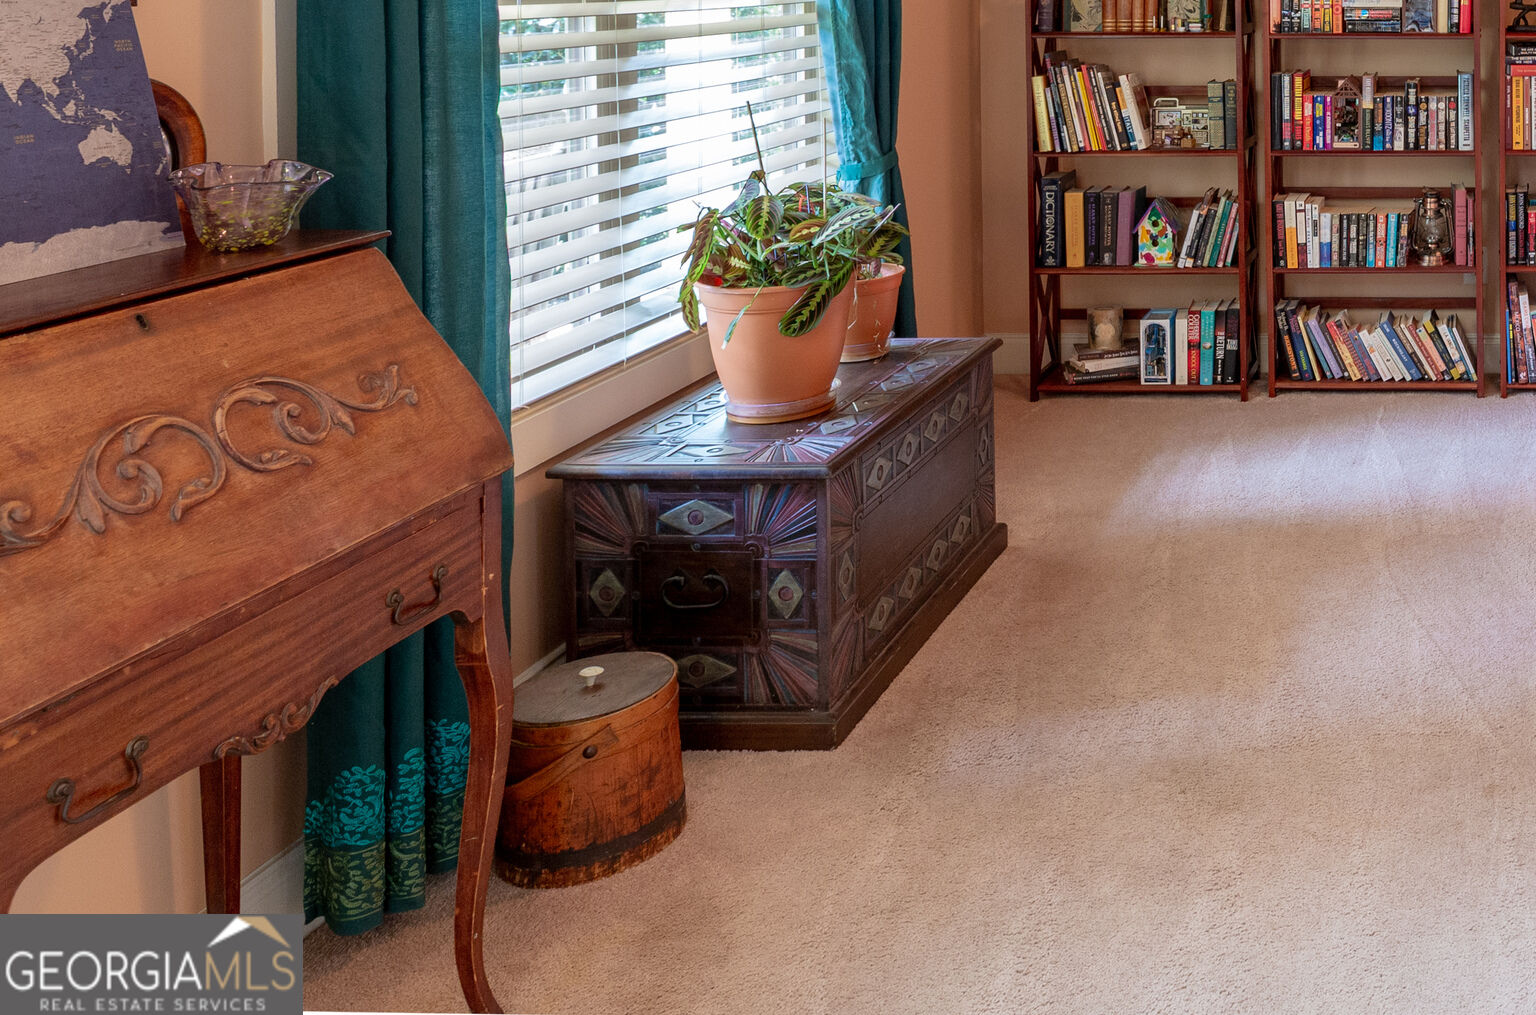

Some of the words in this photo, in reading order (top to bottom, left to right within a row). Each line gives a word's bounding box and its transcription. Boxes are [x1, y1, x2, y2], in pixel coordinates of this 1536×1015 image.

[1463, 77, 1471, 95] PATRICIA
[1463, 96, 1471, 117] CORNWELL
[1384, 109, 1392, 129] KOONTZ
[1463, 119, 1471, 141] SCARPETTA
[1045, 191, 1055, 254] DICTIONARY
[1216, 335, 1225, 359] RETURN
[1283, 335, 1297, 371] BRIMSTONE
[1392, 338, 1408, 362] MOCKINGJAY
